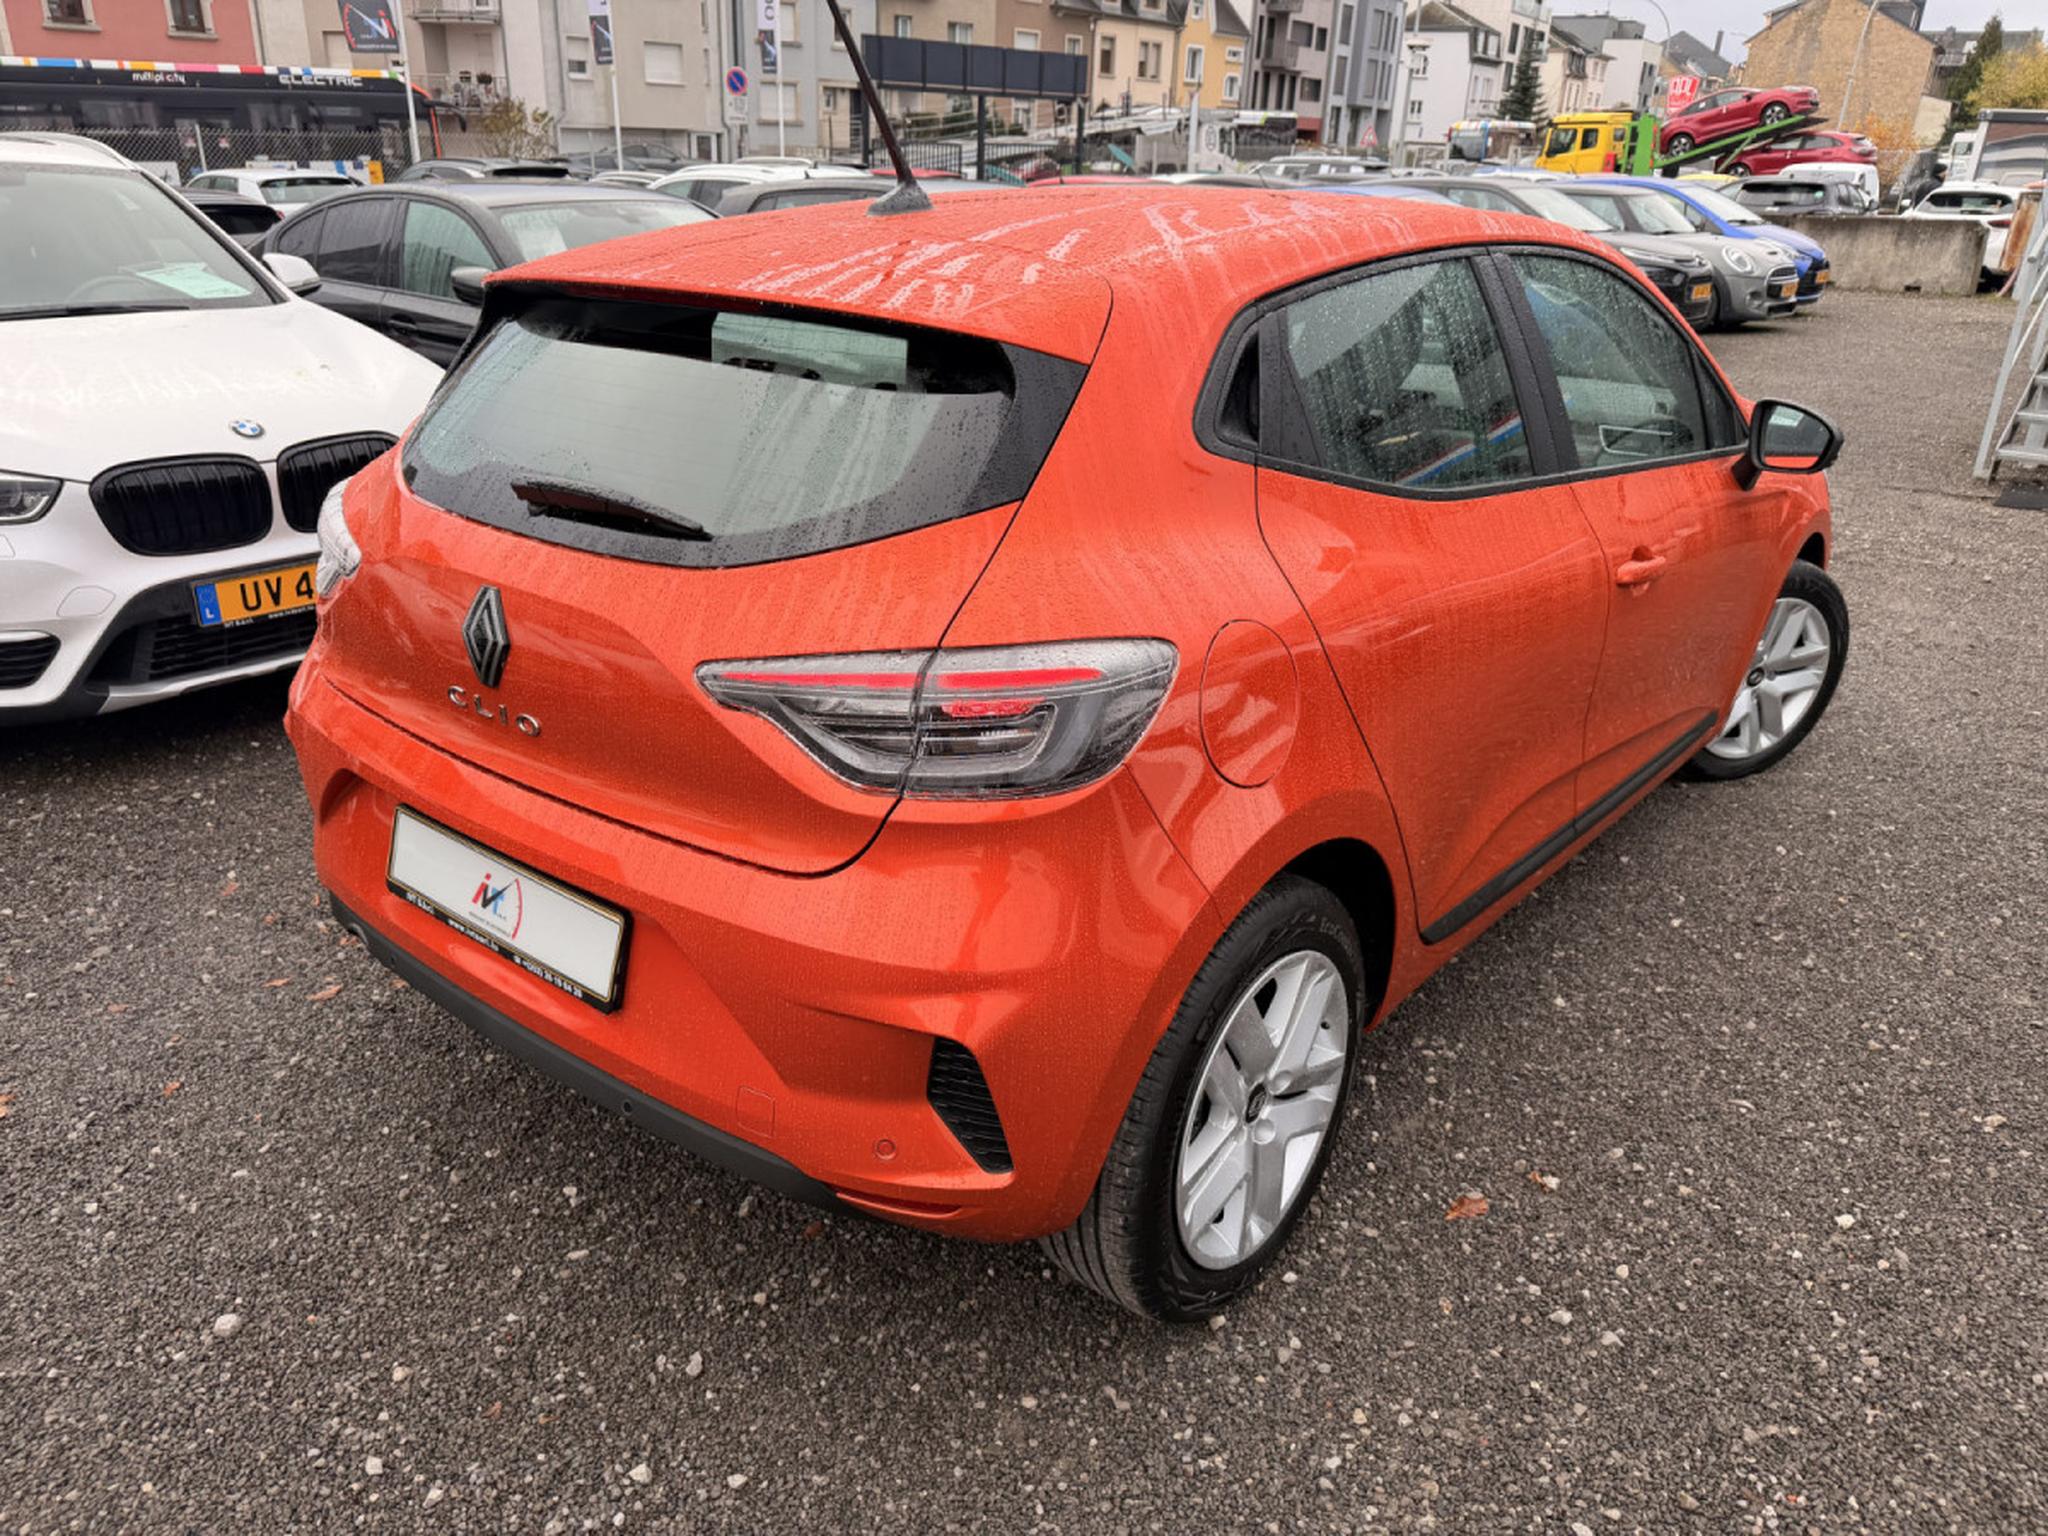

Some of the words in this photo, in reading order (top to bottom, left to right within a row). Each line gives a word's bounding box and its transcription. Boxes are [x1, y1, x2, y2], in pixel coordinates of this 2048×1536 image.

[279, 74, 363, 87] ELECTRIC
[240, 576, 282, 612] UV
[295, 570, 314, 599] 4
[205, 607, 215, 619] L
[447, 684, 542, 737] CLIO
